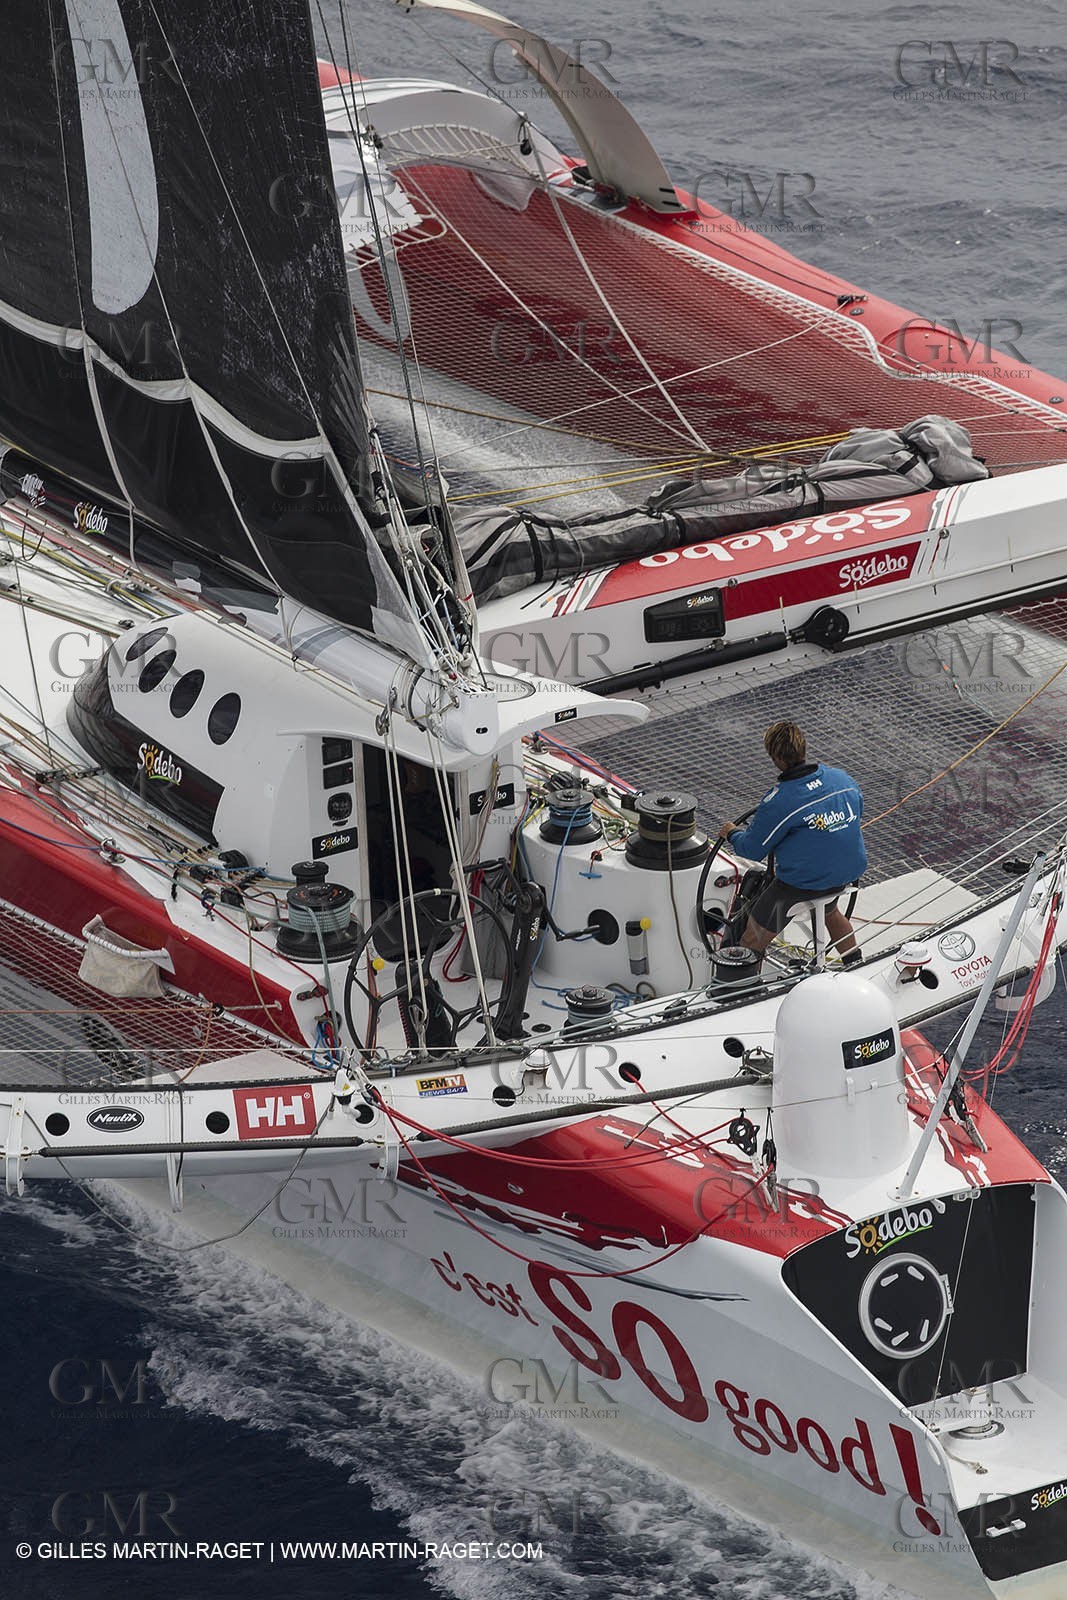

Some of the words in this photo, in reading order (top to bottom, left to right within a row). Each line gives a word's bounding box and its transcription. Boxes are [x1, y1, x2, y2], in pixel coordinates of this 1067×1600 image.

[839, 554, 908, 588] Sodebo
[687, 595, 714, 608] Sodebo
[137, 743, 182, 783] Sodebo
[806, 778, 823, 791] HH
[477, 791, 507, 807] Sbo
[320, 835, 351, 851] Sodebo
[951, 955, 992, 980] TOYOTA
[854, 1038, 890, 1059] Sodebo
[420, 1075, 461, 1090] BFMTV
[245, 1095, 306, 1128] HH
[845, 1207, 933, 1258] Sodebo
[430, 1251, 539, 1326] c'est
[528, 1260, 709, 1423] SO
[714, 1380, 886, 1497] good
[1031, 1484, 1067, 1511] Sodeb
